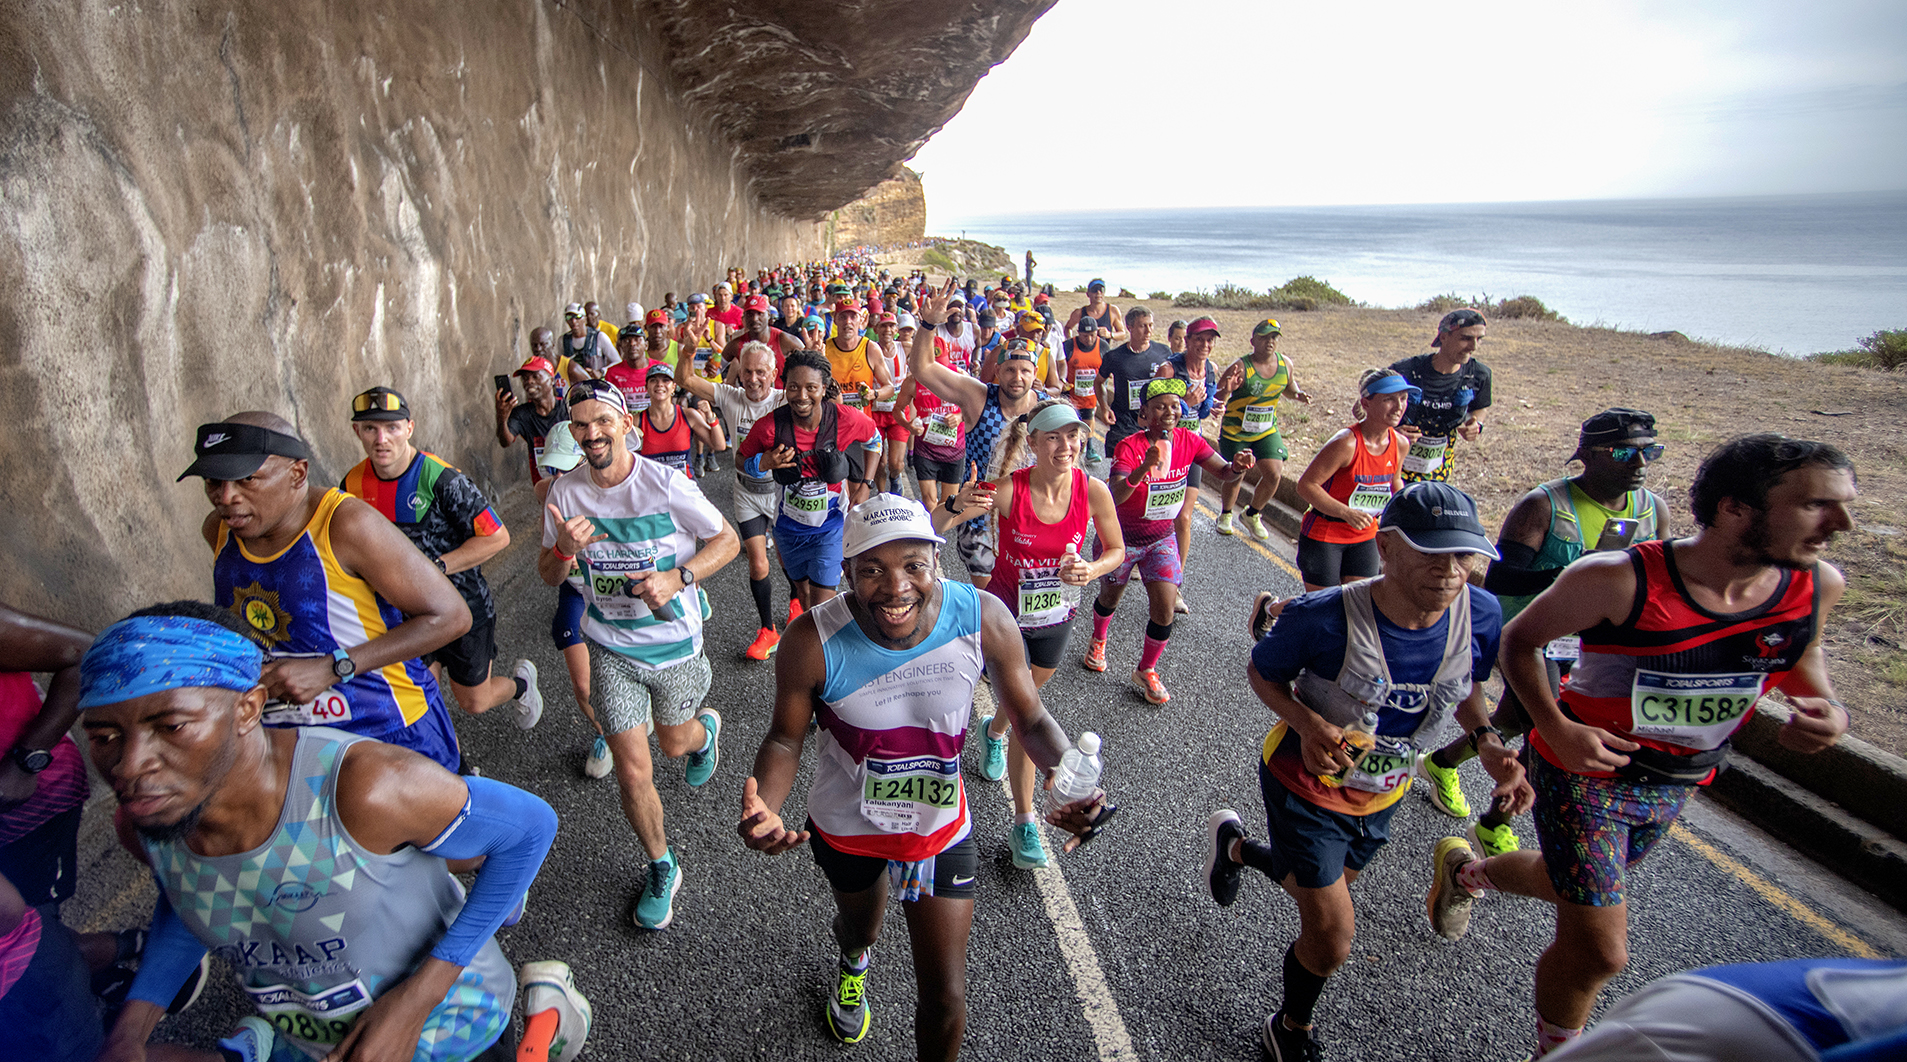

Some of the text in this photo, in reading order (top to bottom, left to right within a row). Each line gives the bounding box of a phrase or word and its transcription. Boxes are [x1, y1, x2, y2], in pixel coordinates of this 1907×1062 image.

[606, 546, 659, 560] HARRIERS
[602, 562, 640, 570] TOTALSPORTS
[885, 661, 955, 684] ENGINEERS
[1665, 678, 1735, 687] TOTALSPORTS
[927, 689, 942, 697] you
[312, 696, 346, 719] 40
[1641, 695, 1749, 724] C31583
[887, 760, 941, 772] TOTALSPORTS
